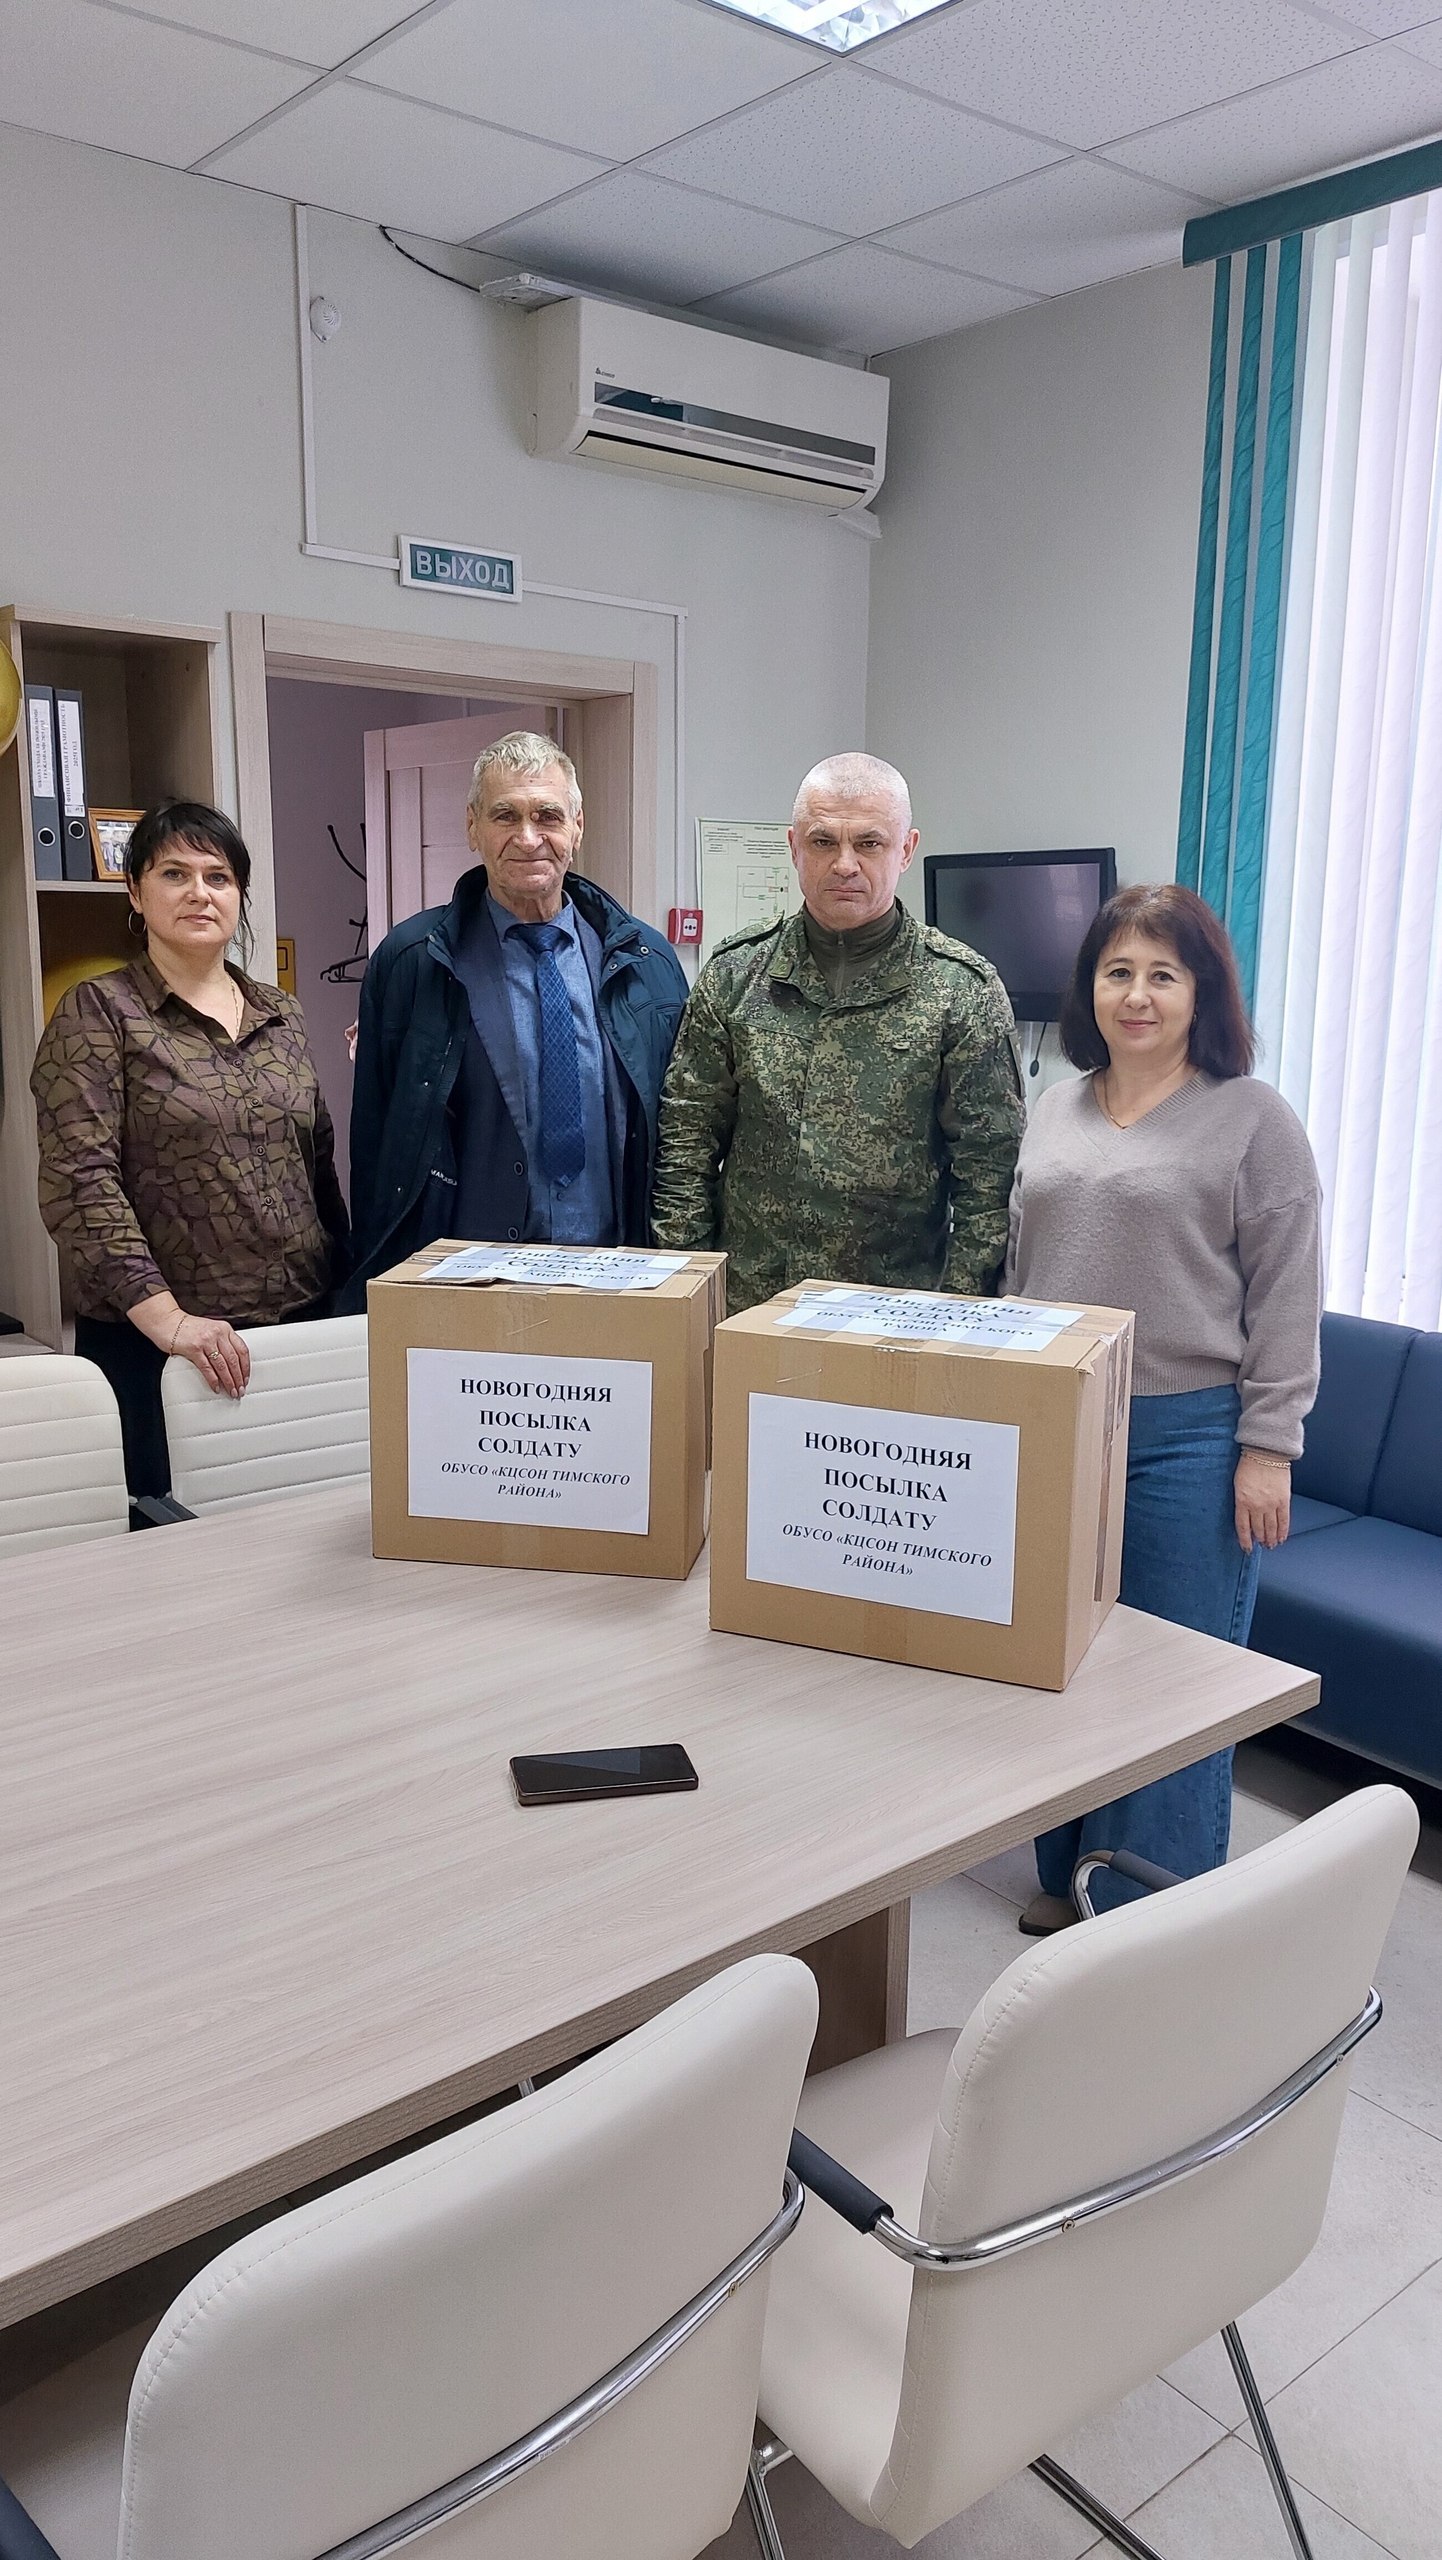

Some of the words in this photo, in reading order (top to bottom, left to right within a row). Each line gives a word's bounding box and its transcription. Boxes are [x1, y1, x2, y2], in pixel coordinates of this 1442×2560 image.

[416, 550, 510, 590] ВЫХОД
[460, 1378, 613, 1403] НОВОГОДНЯЯ
[479, 1409, 592, 1432] ПОСЫЛКА
[477, 1436, 582, 1459] СОЛДАТУ
[804, 1431, 973, 1471] НОВОГОДНЯЯ
[441, 1461, 489, 1476] ОБУСО
[491, 1466, 549, 1481] «КЦСОН
[552, 1470, 631, 1486] ТИМСКОГО
[823, 1467, 948, 1503] ПОСЫЛКА
[497, 1483, 562, 1499] РАЙОНА»
[822, 1498, 937, 1531] СОЛДАТУ
[782, 1523, 833, 1542] ОБУСО
[836, 1533, 899, 1553] «КЦСОН
[902, 1542, 992, 1567] ТИМСКОГО
[841, 1553, 914, 1576] РАЙОНА»
